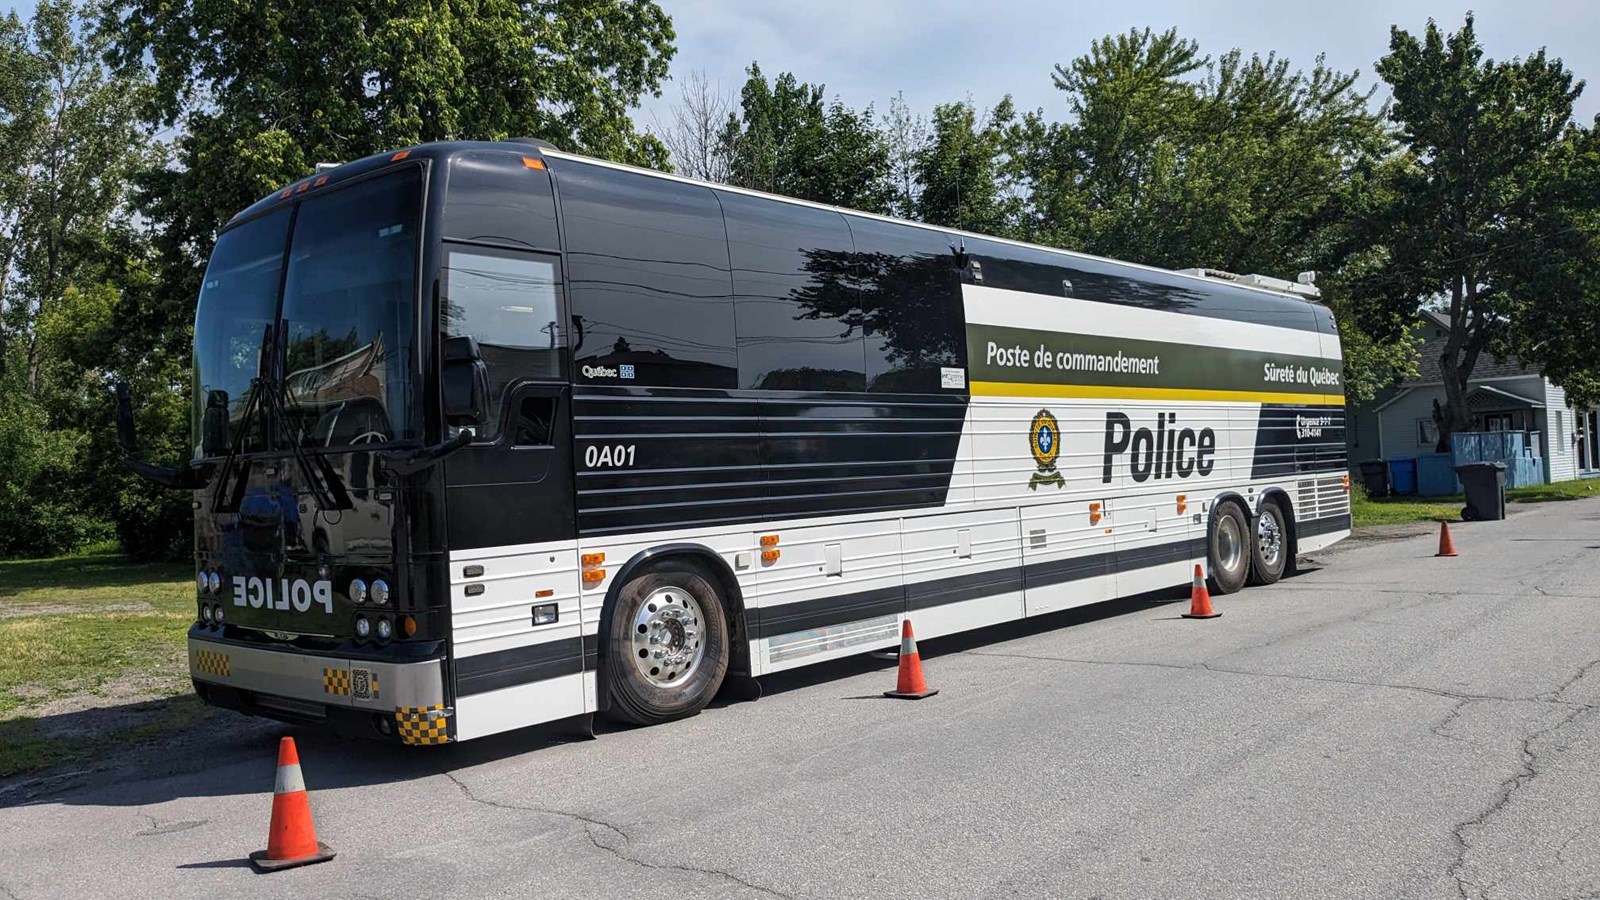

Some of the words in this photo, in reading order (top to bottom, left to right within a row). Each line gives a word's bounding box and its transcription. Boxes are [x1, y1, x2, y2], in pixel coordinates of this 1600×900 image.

[986, 341, 1030, 367] Poste
[1034, 344, 1053, 369] de
[1056, 351, 1160, 375] commandement
[582, 365, 618, 378] Québec
[1264, 363, 1294, 383] Sûreté
[1296, 366, 1308, 384] du
[1309, 367, 1340, 387] Québec
[585, 445, 636, 468] 0A01
[1102, 411, 1216, 484] Police
